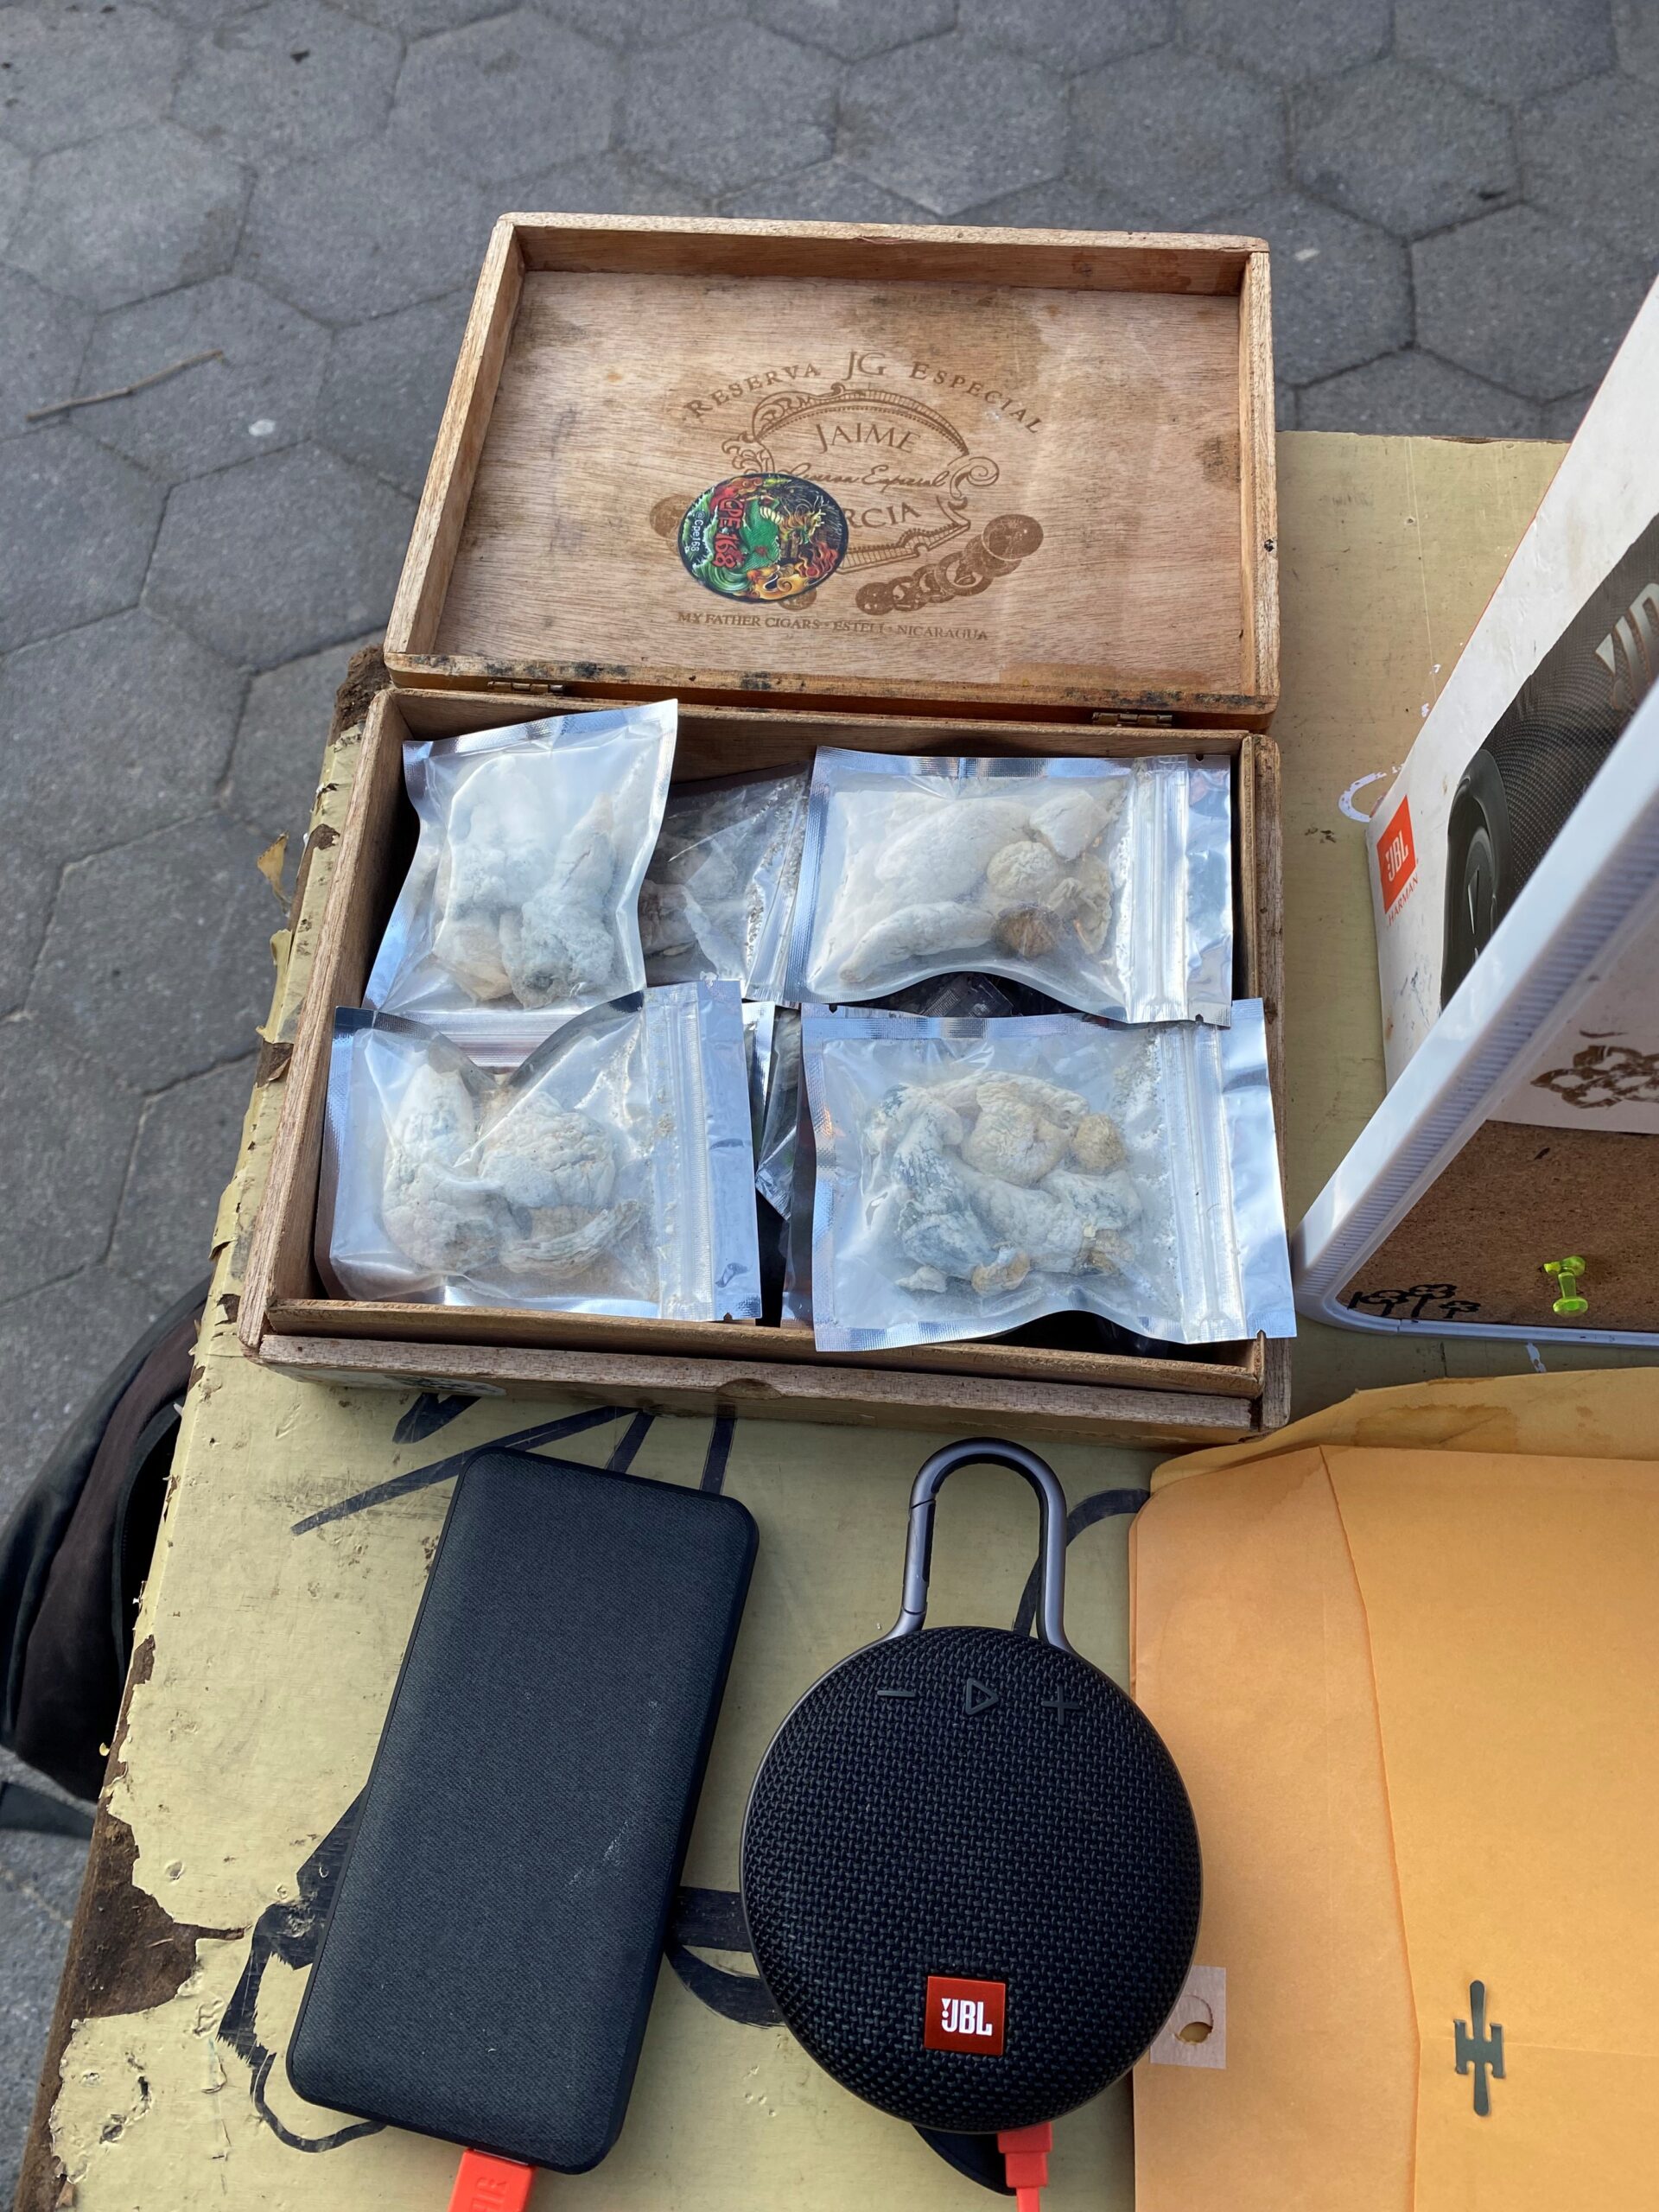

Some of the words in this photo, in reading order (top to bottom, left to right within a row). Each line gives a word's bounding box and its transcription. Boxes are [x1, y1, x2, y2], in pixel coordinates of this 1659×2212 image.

[683, 362, 821, 418] RESERVA
[842, 351, 886, 381] JG
[909, 361, 1043, 433] ESPECIAL
[816, 423, 921, 454] JAIME
[690, 512, 706, 551] @Cpe168
[717, 498, 744, 530] CPE
[844, 501, 921, 529] RCIA
[712, 532, 740, 569] 168
[677, 611, 702, 624] MY
[704, 613, 760, 626] FATHER
[765, 617, 820, 630] CIGARS
[897, 624, 988, 641] NICARAGUA
[1385, 830, 1409, 882] JBL
[1388, 874, 1419, 926] HARMAN
[941, 1998, 993, 2036] JBL
